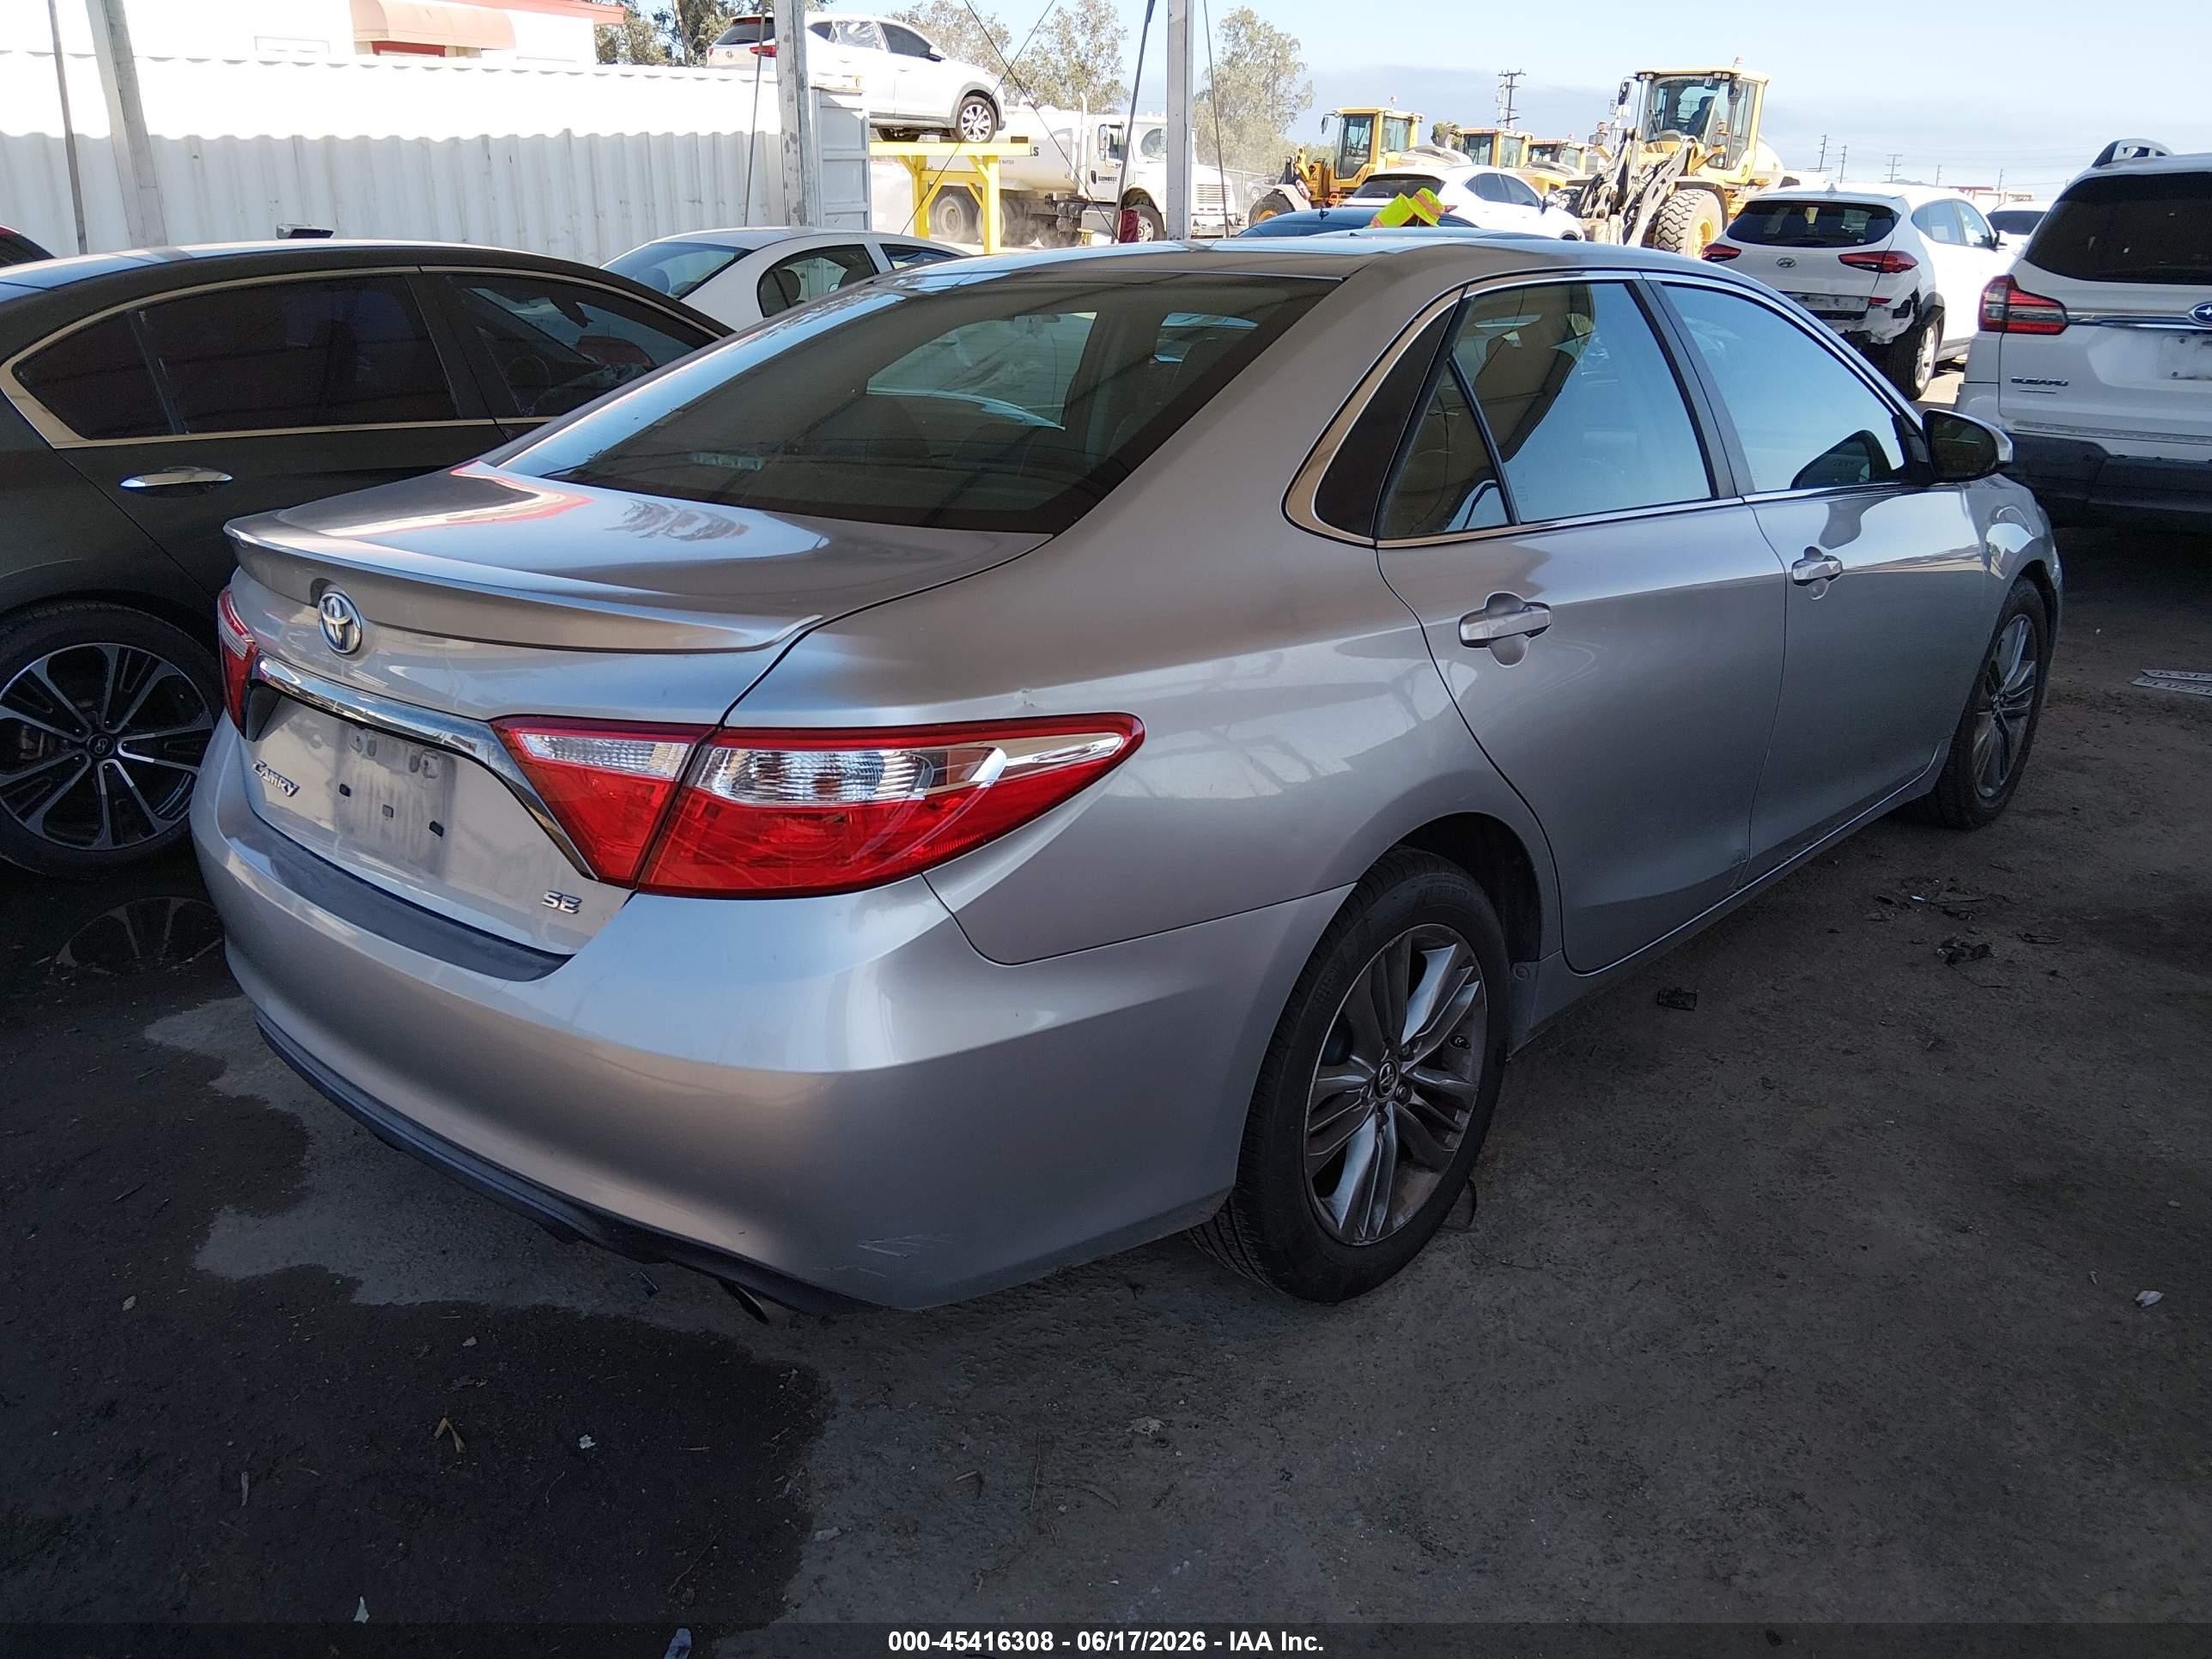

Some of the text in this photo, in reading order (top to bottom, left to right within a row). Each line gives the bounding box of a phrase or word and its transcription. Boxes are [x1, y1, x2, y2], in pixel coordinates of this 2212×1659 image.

[2011, 376, 2069, 386] SUBARU
[252, 760, 301, 797] CAMRY
[542, 890, 582, 914] SE
